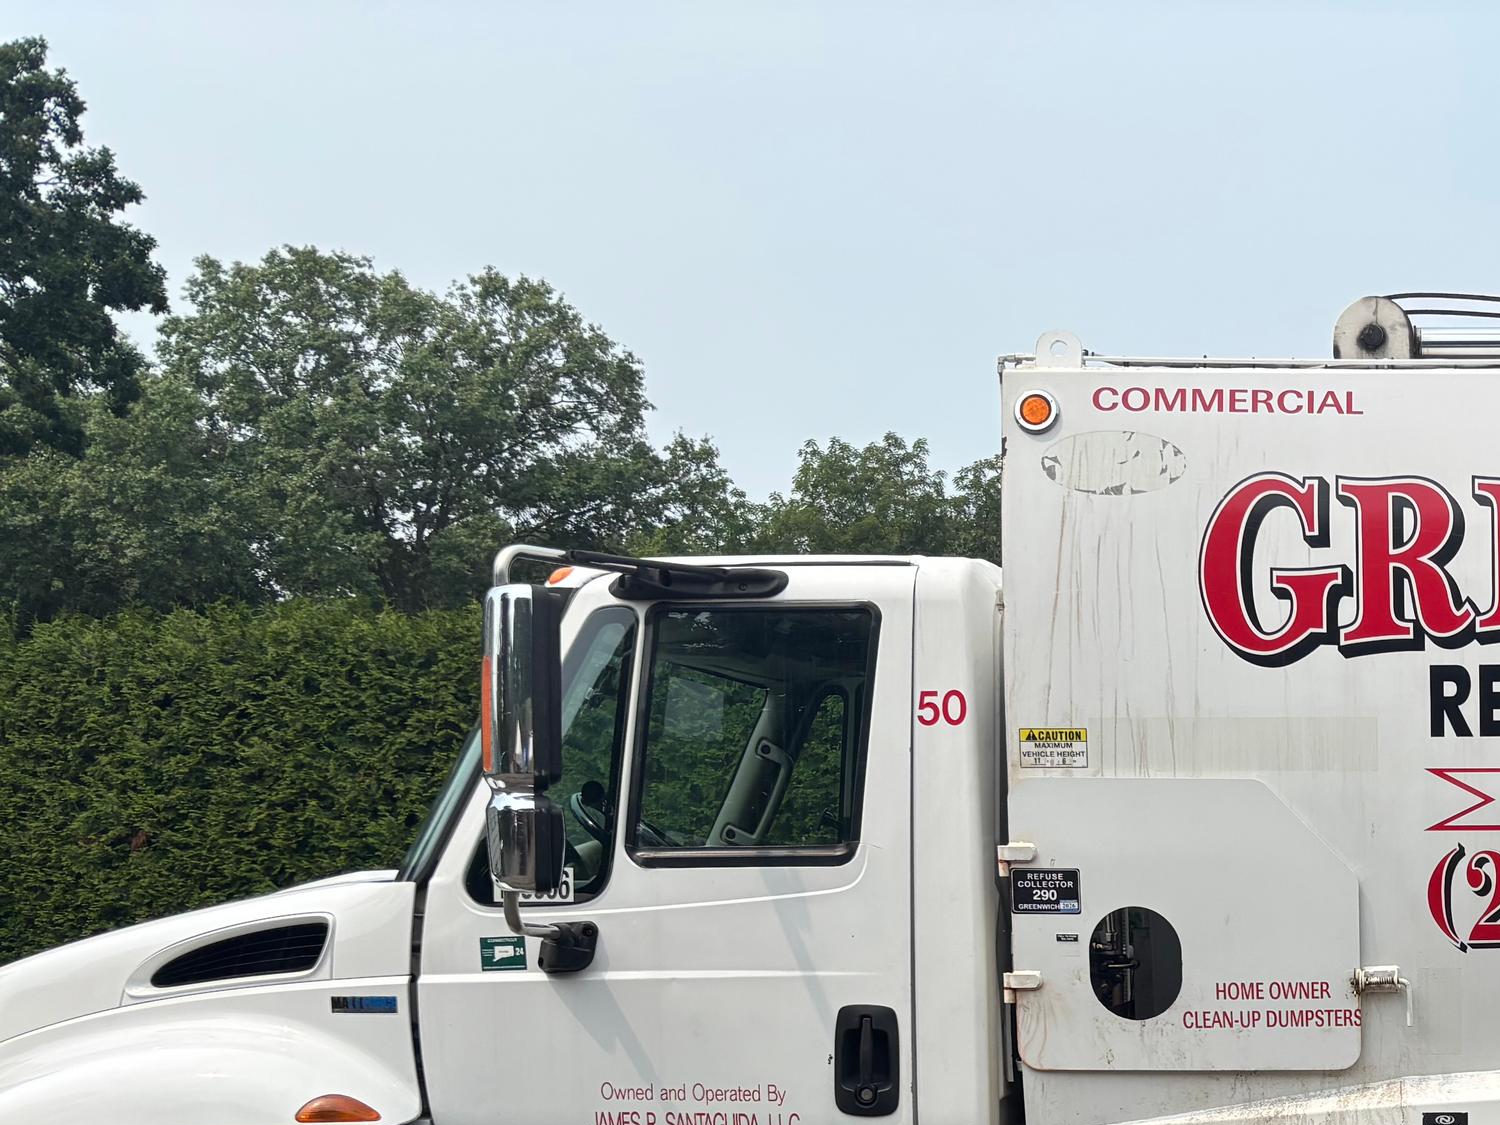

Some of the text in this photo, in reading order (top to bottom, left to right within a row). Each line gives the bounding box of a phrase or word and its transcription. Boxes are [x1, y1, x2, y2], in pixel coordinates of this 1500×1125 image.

[1091, 387, 1364, 415] COMMERCIAL
[917, 689, 967, 726] 50
[1038, 730, 1082, 741] CAUTION
[1017, 880, 1074, 888] COLLECTOR
[1032, 889, 1057, 901] 290
[1215, 981, 1332, 1001] HOME OWNER
[1182, 1009, 1362, 1029] CLEAN-UP DUMPSTERS
[600, 1081, 787, 1106] Owned and Operated By
